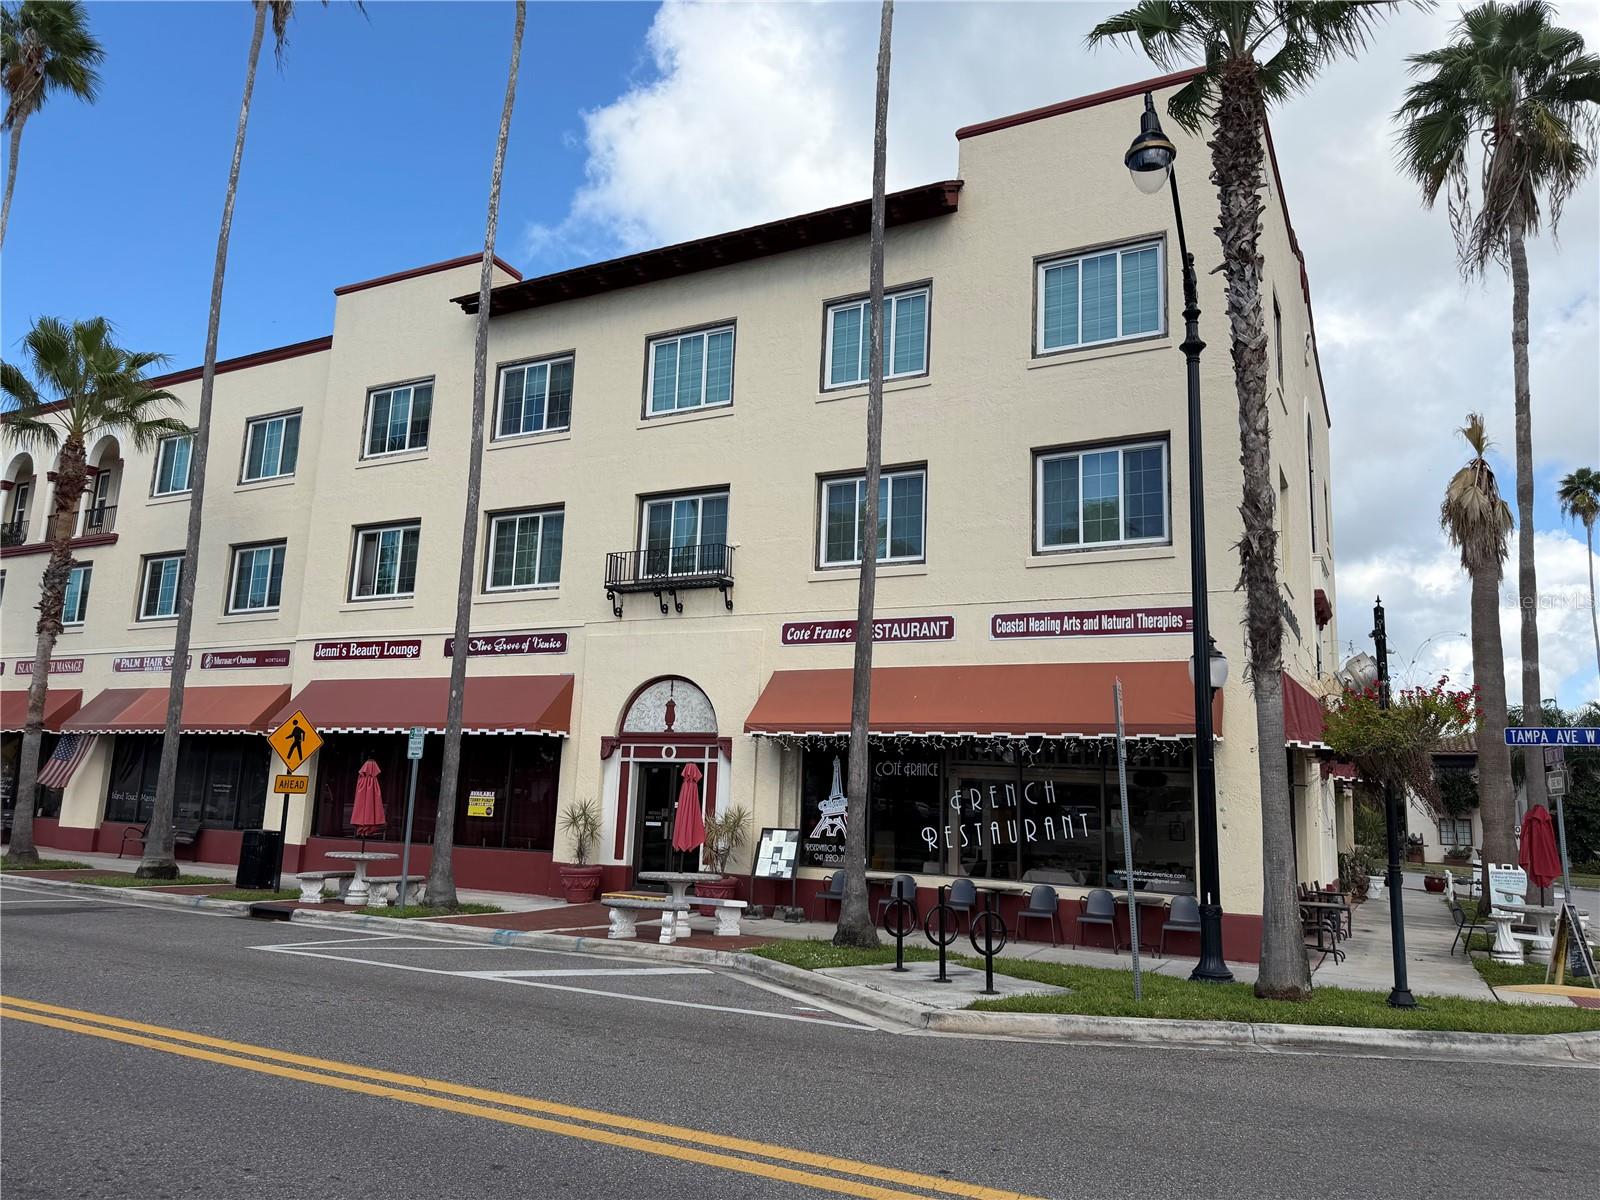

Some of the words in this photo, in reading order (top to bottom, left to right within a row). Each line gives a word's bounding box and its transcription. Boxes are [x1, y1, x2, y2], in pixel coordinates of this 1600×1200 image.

[814, 626, 852, 639] France
[872, 621, 949, 639] STAURANT
[996, 618, 1027, 633] Coastal
[1028, 616, 1060, 634] Healing
[1063, 616, 1081, 630] Arts
[1083, 615, 1099, 630] and
[1102, 614, 1134, 629] Natural
[1136, 612, 1183, 631] Therapies
[316, 644, 347, 657] Jenni's
[350, 643, 382, 658] Beauty
[384, 642, 418, 657] Lounge
[522, 637, 531, 652] of
[532, 637, 563, 649] Venice
[17, 662, 35, 673] ISLAN
[56, 660, 82, 672] MASSAGE
[120, 658, 140, 668] PALM
[144, 657, 162, 667] HAIR
[1510, 730, 1548, 743] TAMPA
[1556, 730, 1578, 743] AVE
[1586, 730, 1594, 743] W
[904, 762, 938, 776] FRANCE
[279, 780, 304, 789] AHEAD
[950, 780, 1056, 814] FRENCH
[922, 814, 1088, 852] RESTAURANT
